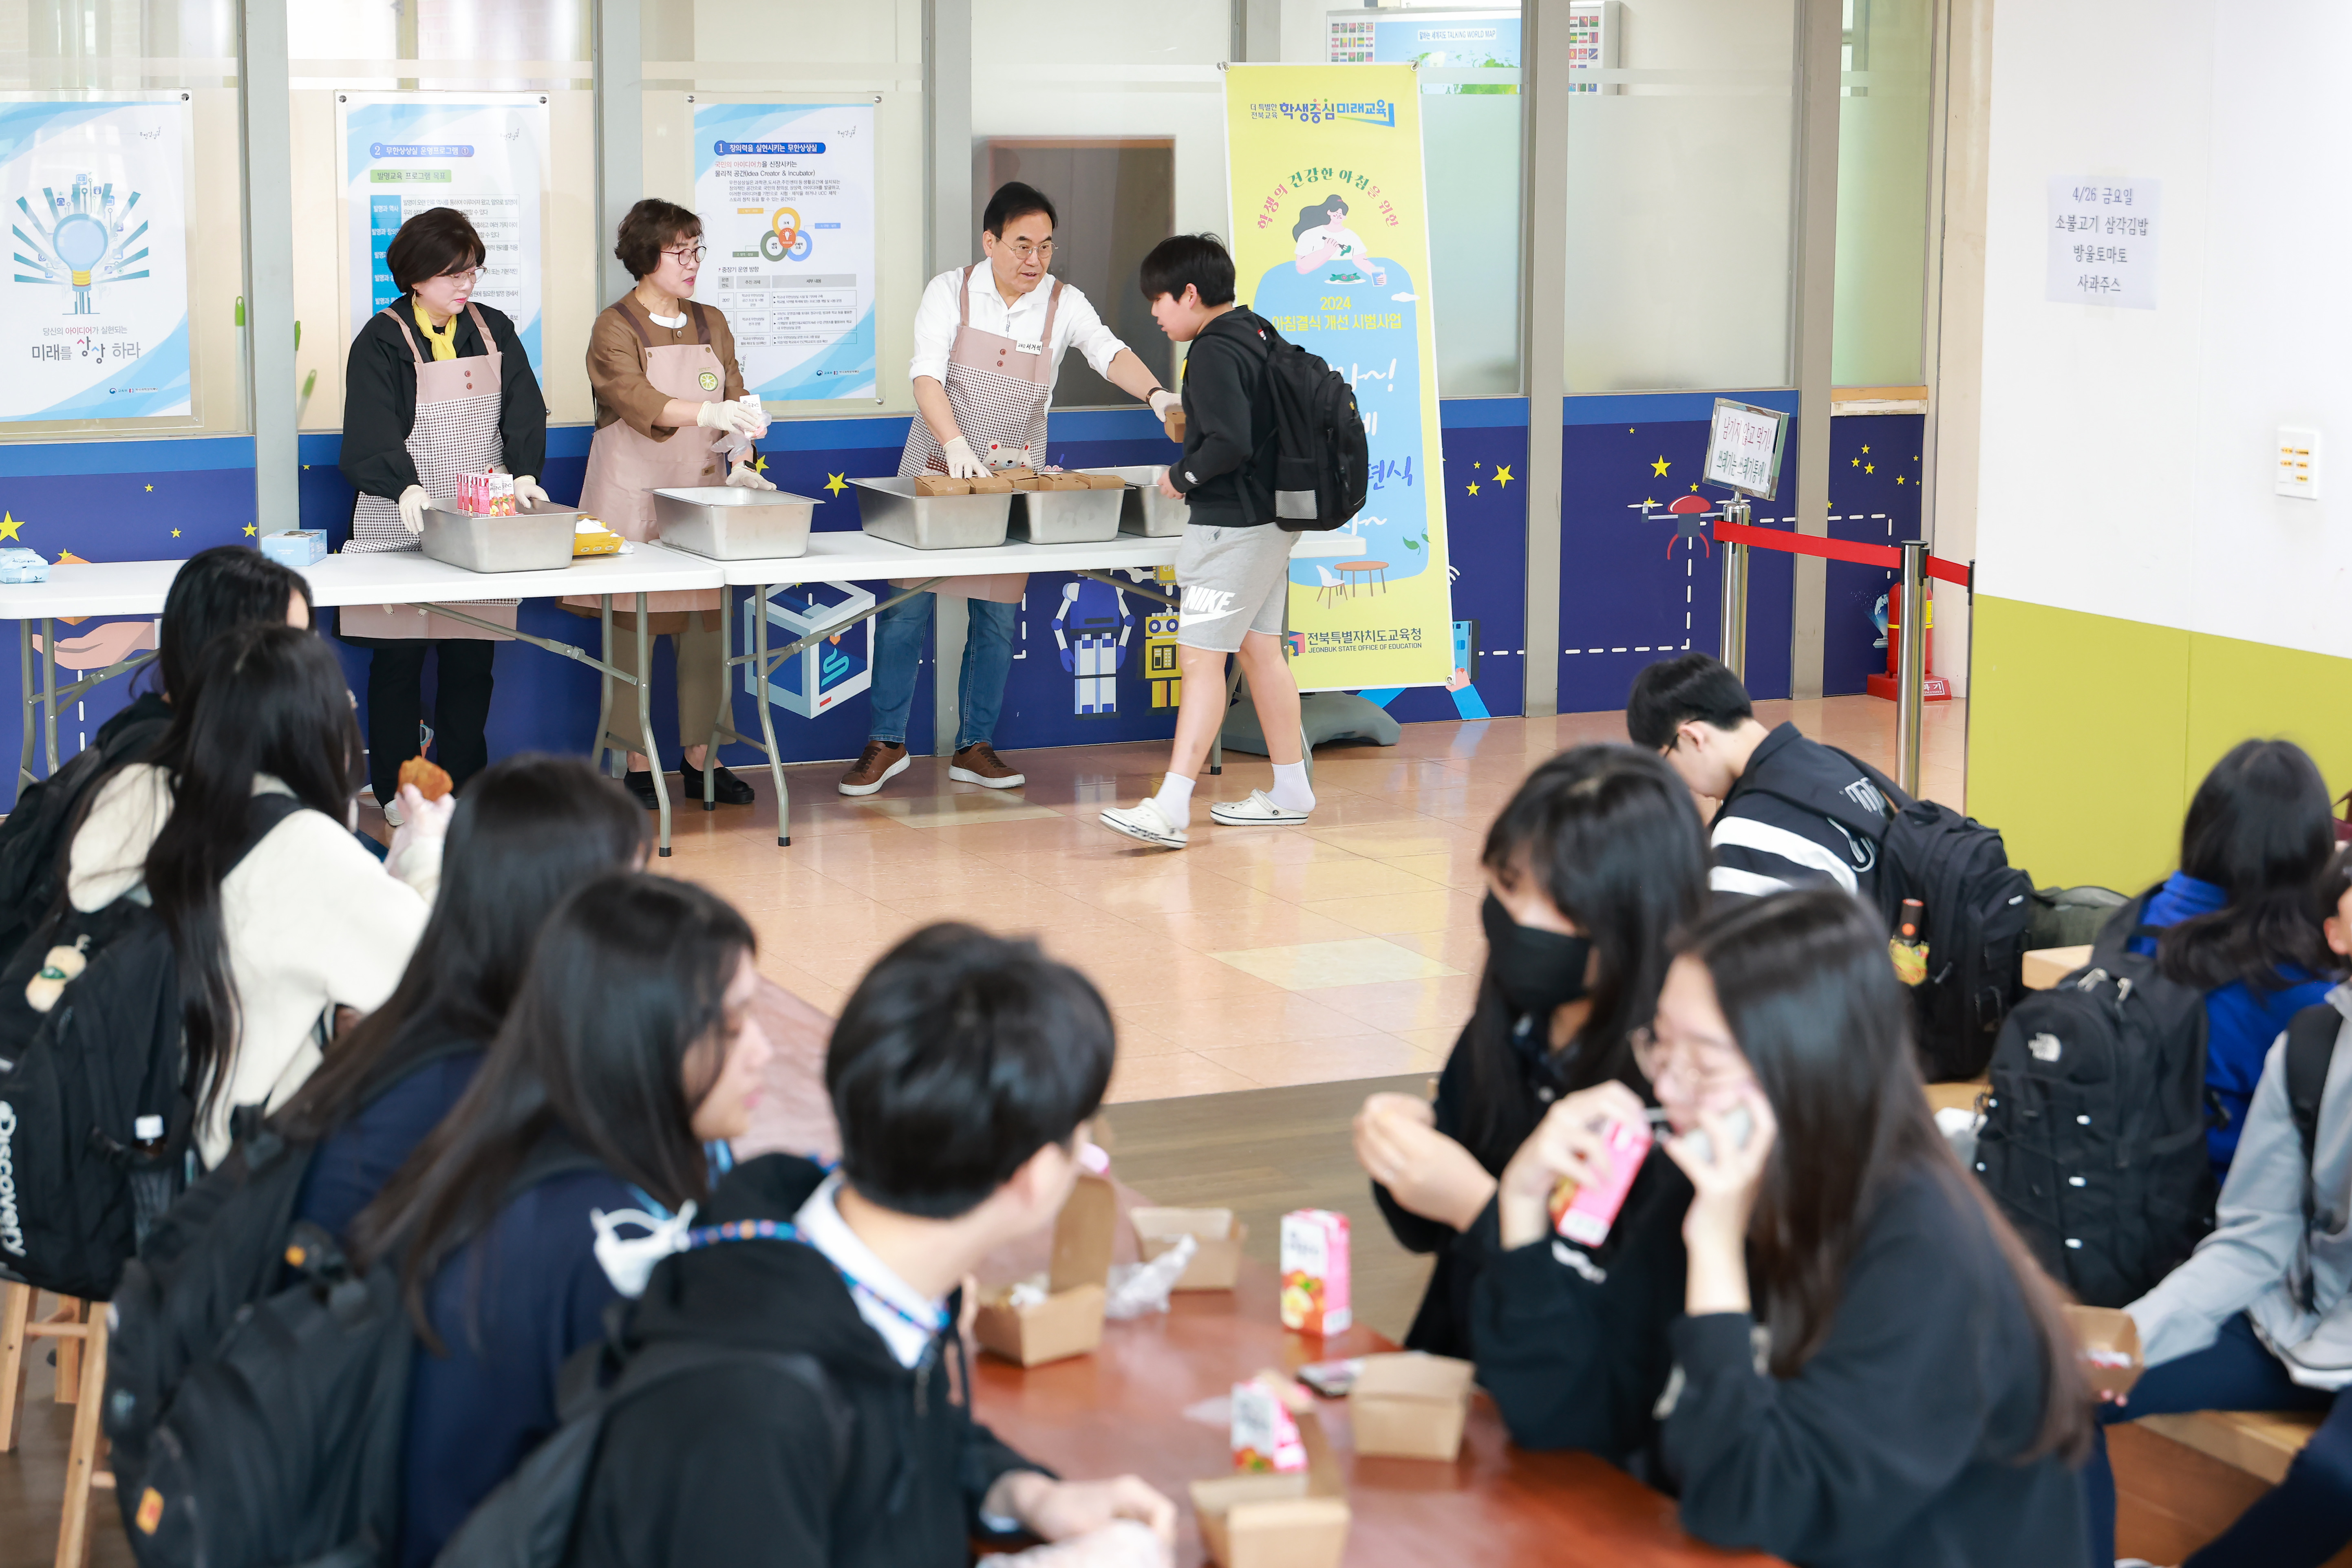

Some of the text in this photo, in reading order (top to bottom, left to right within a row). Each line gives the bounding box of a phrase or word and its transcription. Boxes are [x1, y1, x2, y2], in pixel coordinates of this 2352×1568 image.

[1258, 103, 1277, 111] 특별한
[375, 146, 380, 155] 2
[386, 146, 418, 155] 무한상상실
[420, 146, 459, 155] 운영프로그램
[719, 144, 817, 152] 1 창의력을 실현시키는 무한상상실
[377, 172, 446, 180] 발명교육 프로그램 목표
[1258, 167, 1399, 229] 학생의 건강한 아침을 위한
[2072, 186, 2132, 205] 4/26 금요일
[2055, 215, 2148, 236] 소불고기 삼각김밥
[2073, 244, 2127, 264] 방울토마토
[2077, 274, 2121, 294] 사과주스
[1320, 296, 1352, 311] 2024
[43, 326, 128, 336] 당신의 아이디어가 실현되는
[1272, 313, 1402, 331] 아침결식 개선 시범사업
[32, 336, 141, 364] 미래를 상상 하라
[1723, 417, 1772, 452] 남기지 않고 먹기!
[1367, 456, 1413, 490] 편식
[1717, 450, 1766, 485] 쓰레기는 쓰레기통에!
[1184, 585, 1236, 612] NIKE
[1308, 628, 1421, 645] 전북특별자치도교육청
[1924, 683, 1942, 691] 화기
